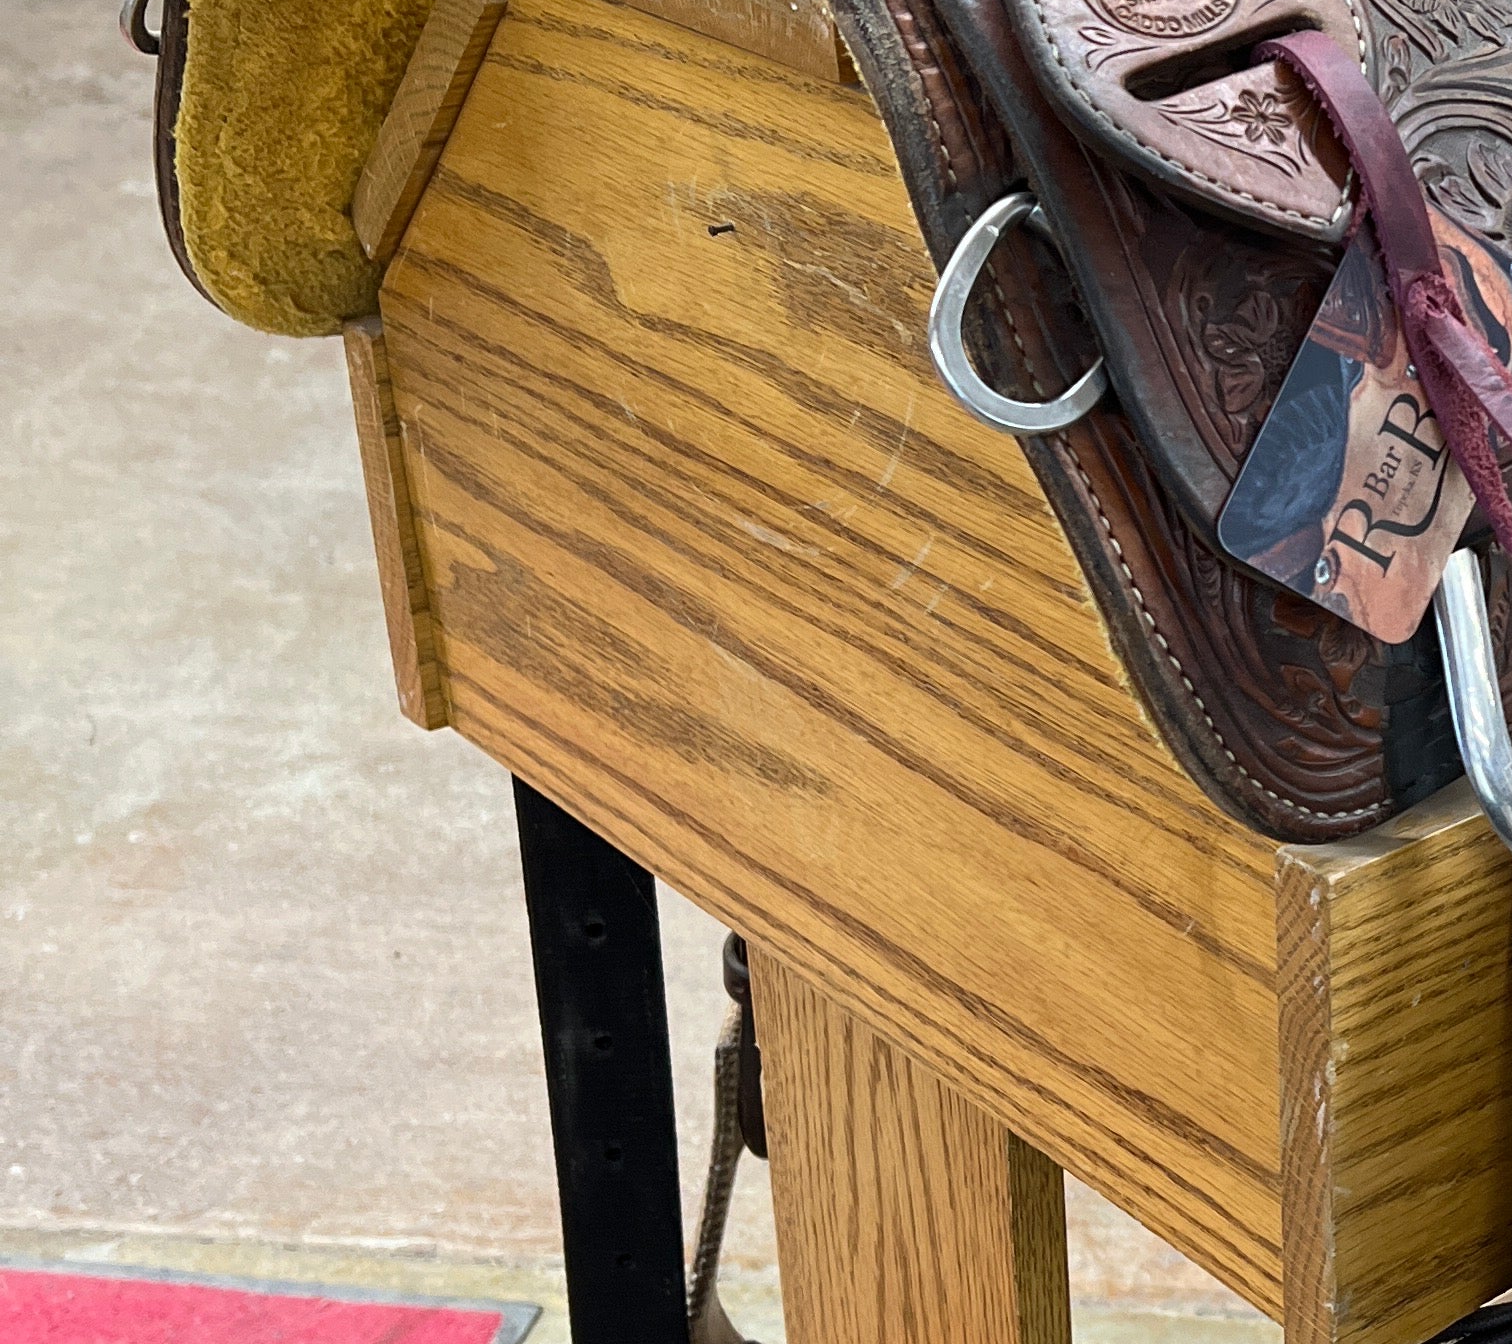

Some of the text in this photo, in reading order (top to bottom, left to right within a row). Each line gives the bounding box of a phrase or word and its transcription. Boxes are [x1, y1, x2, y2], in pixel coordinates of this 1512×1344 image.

[1115, 5, 1181, 33] CADDO
[1377, 393, 1448, 471] B
[1363, 445, 1403, 500] Bar
